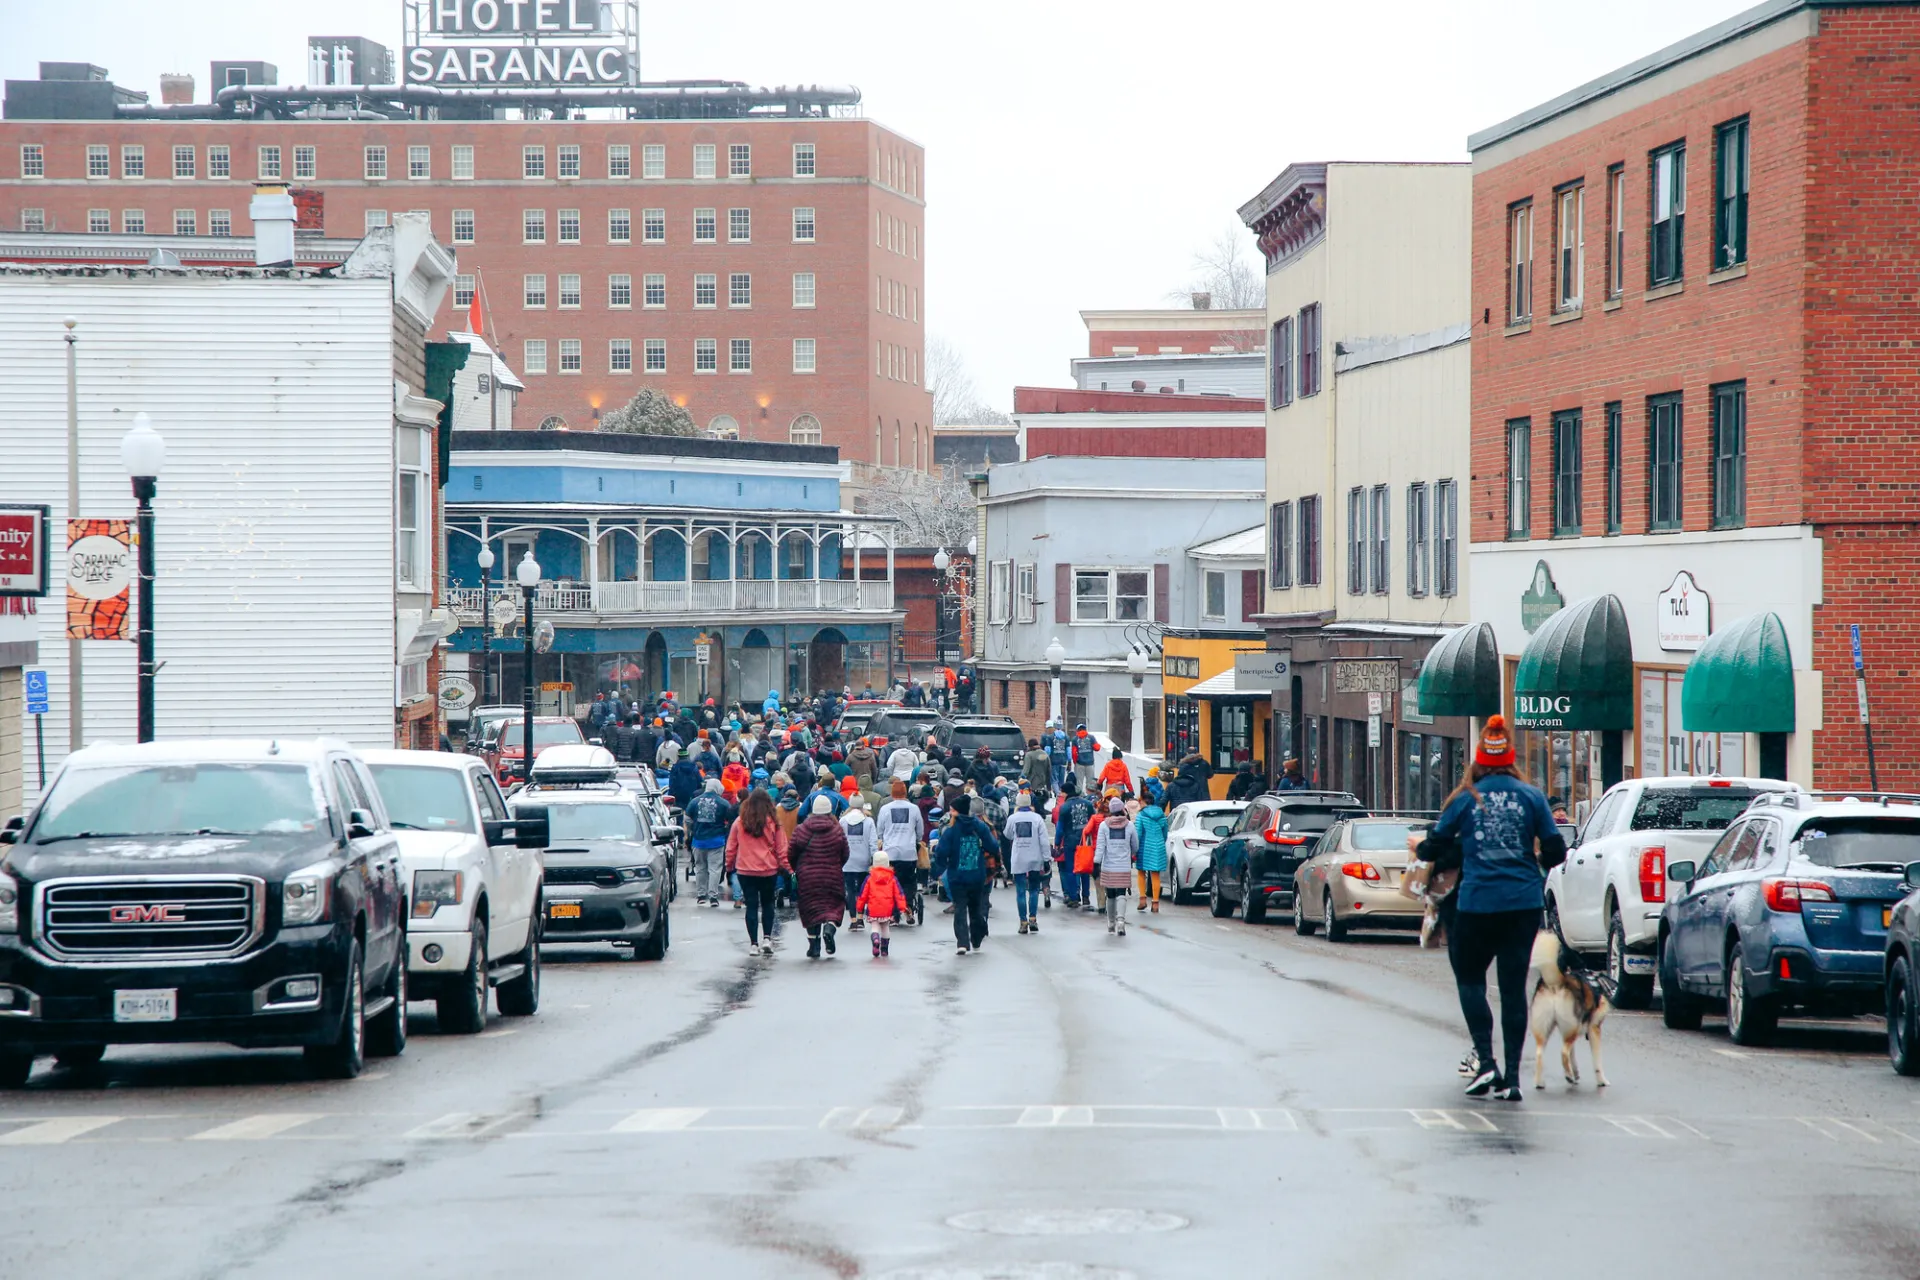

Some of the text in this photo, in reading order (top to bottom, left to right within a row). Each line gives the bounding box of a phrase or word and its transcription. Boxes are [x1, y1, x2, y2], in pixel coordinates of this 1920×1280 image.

[436, 0, 593, 31] HOTEL
[408, 47, 622, 81] SARANAC
[71, 553, 127, 578] SARANAC
[86, 566, 114, 583] LAKE
[1340, 663, 1397, 677] ADIRONDACK
[1521, 696, 1571, 713] BLDG
[110, 904, 186, 922] GMC
